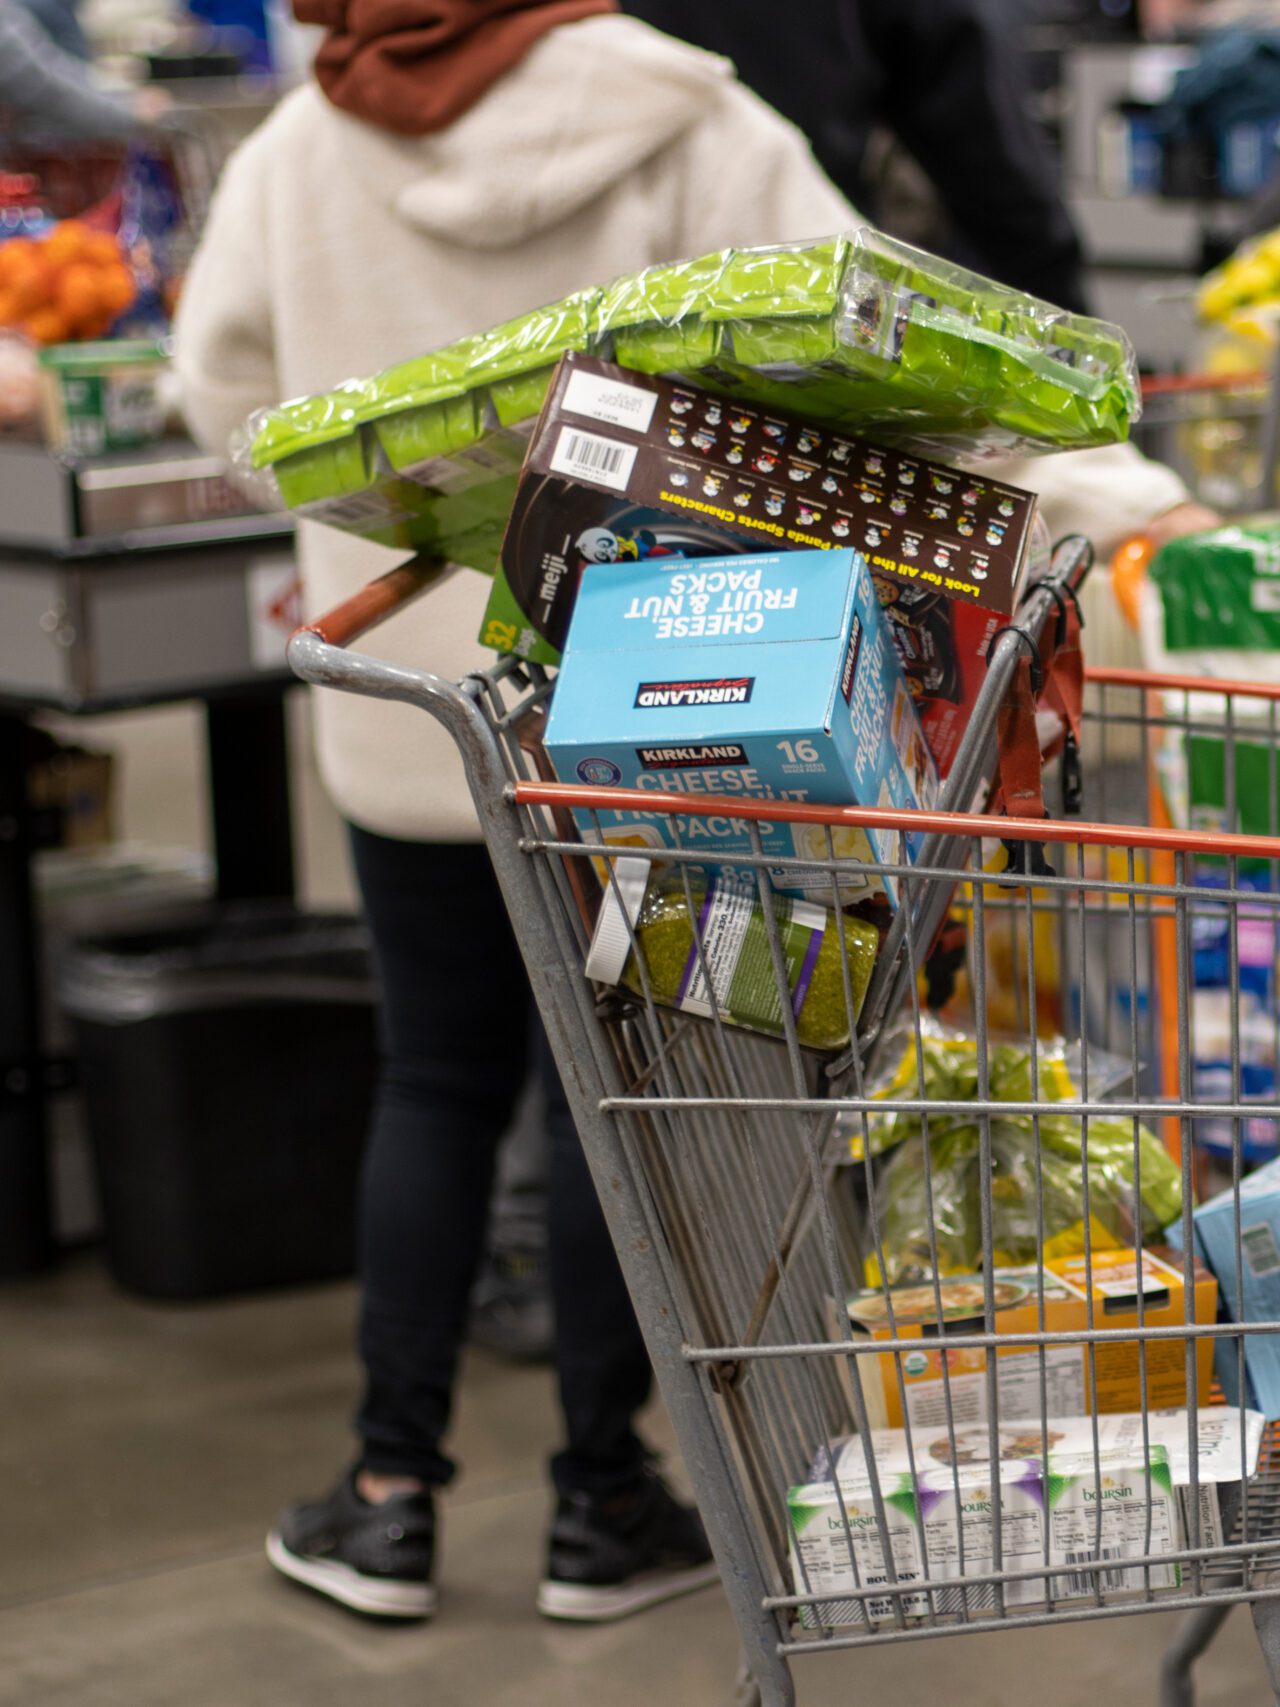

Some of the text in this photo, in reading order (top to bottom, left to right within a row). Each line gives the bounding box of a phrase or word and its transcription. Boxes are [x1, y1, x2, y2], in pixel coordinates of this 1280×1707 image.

[657, 489, 831, 551] Panda Sports Characters
[539, 553, 569, 602] meiji
[671, 569, 762, 595] PACKS
[871, 555, 980, 597] Look for All the
[624, 587, 798, 619] FRUIT & NUT
[484, 620, 517, 651] 32
[512, 627, 537, 657] Bags
[841, 614, 861, 697] KIRKLAND
[638, 687, 748, 707] KIRKLAND
[854, 706, 873, 786] FRUIT
[870, 628, 886, 685] NUT
[868, 684, 888, 772] PACKS
[642, 740, 819, 763] KIRKLAND 16
[636, 768, 771, 793] CHEESE,
[665, 817, 775, 841] PACKS
[709, 931, 722, 959] Calories
[959, 1500, 1004, 1514] ours
[1082, 1484, 1133, 1502] boursin
[1199, 1485, 1211, 1528] Nutrition
[866, 1571, 917, 1585] BOSIN
